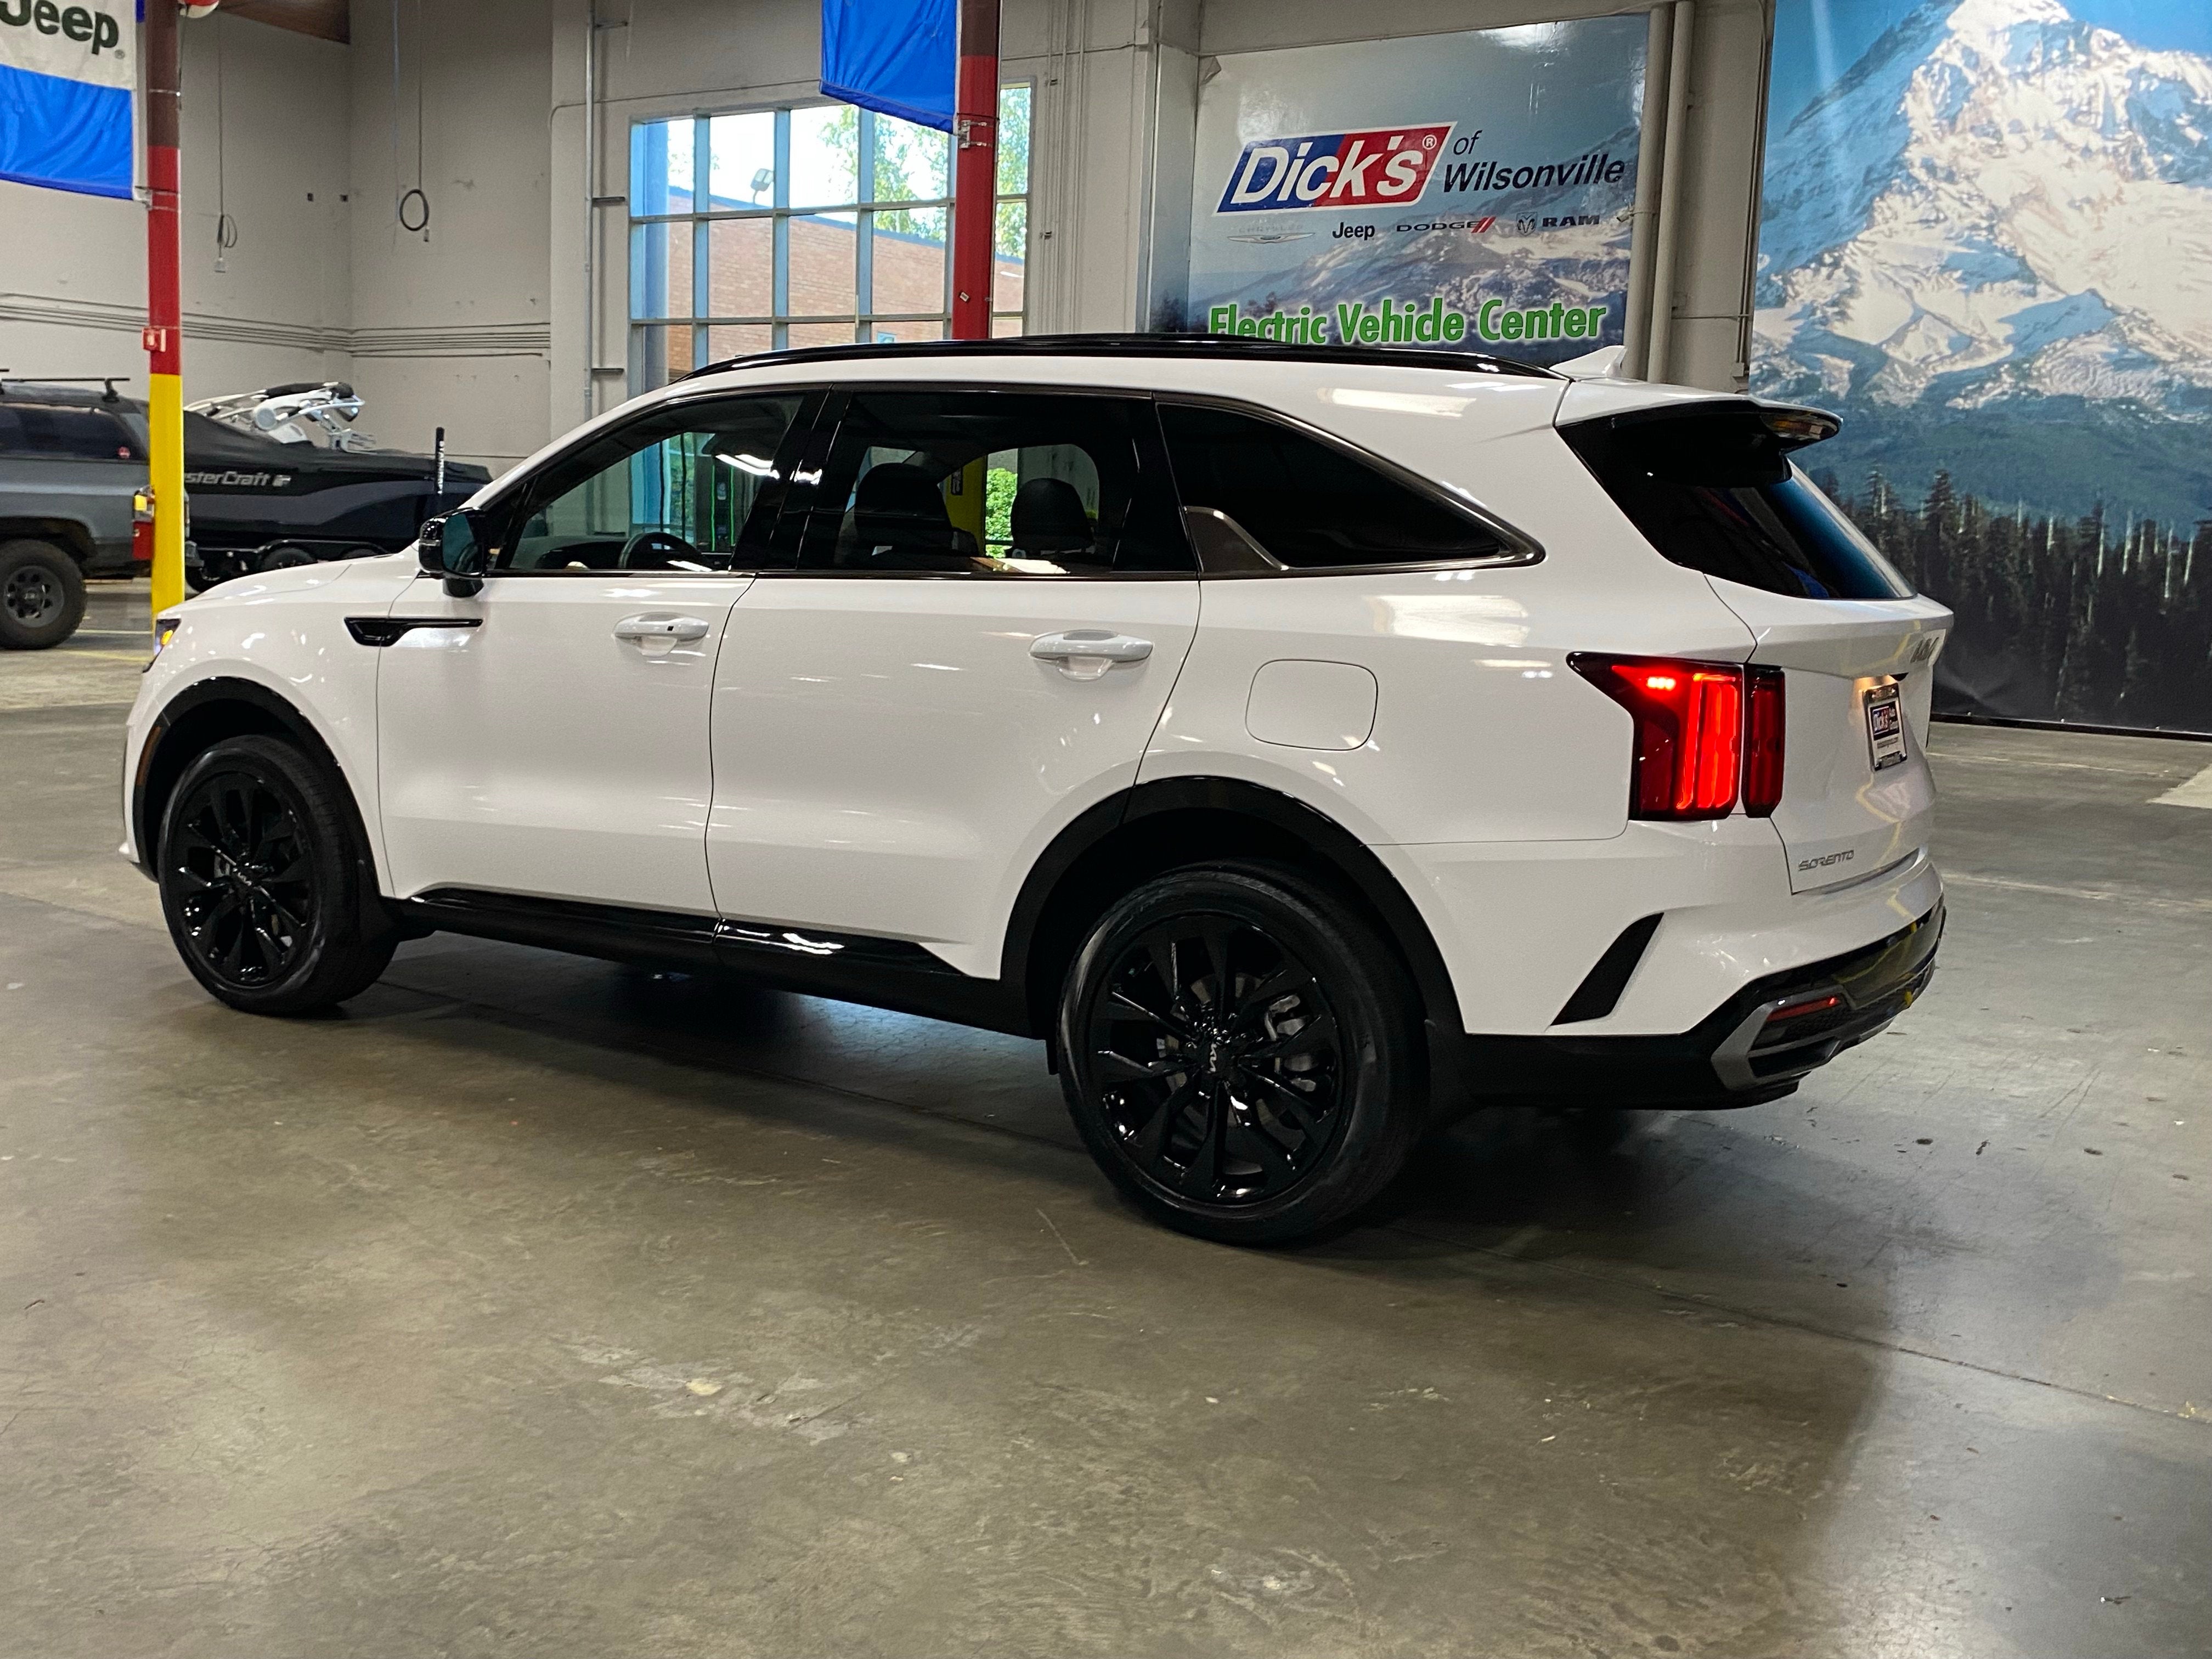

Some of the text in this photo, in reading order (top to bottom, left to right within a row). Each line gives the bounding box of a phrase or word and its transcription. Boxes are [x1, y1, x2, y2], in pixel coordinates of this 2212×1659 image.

[1453, 130, 1482, 155] of
[1443, 154, 1626, 193] Wilsonville
[1332, 222, 1375, 240] Jeep
[1396, 221, 1481, 232] DODGE
[1542, 215, 1601, 228] RAM
[1210, 297, 1607, 343] Electric Vehicle Center
[184, 471, 271, 486] sterCraft
[1798, 849, 1854, 871] SORENTO
